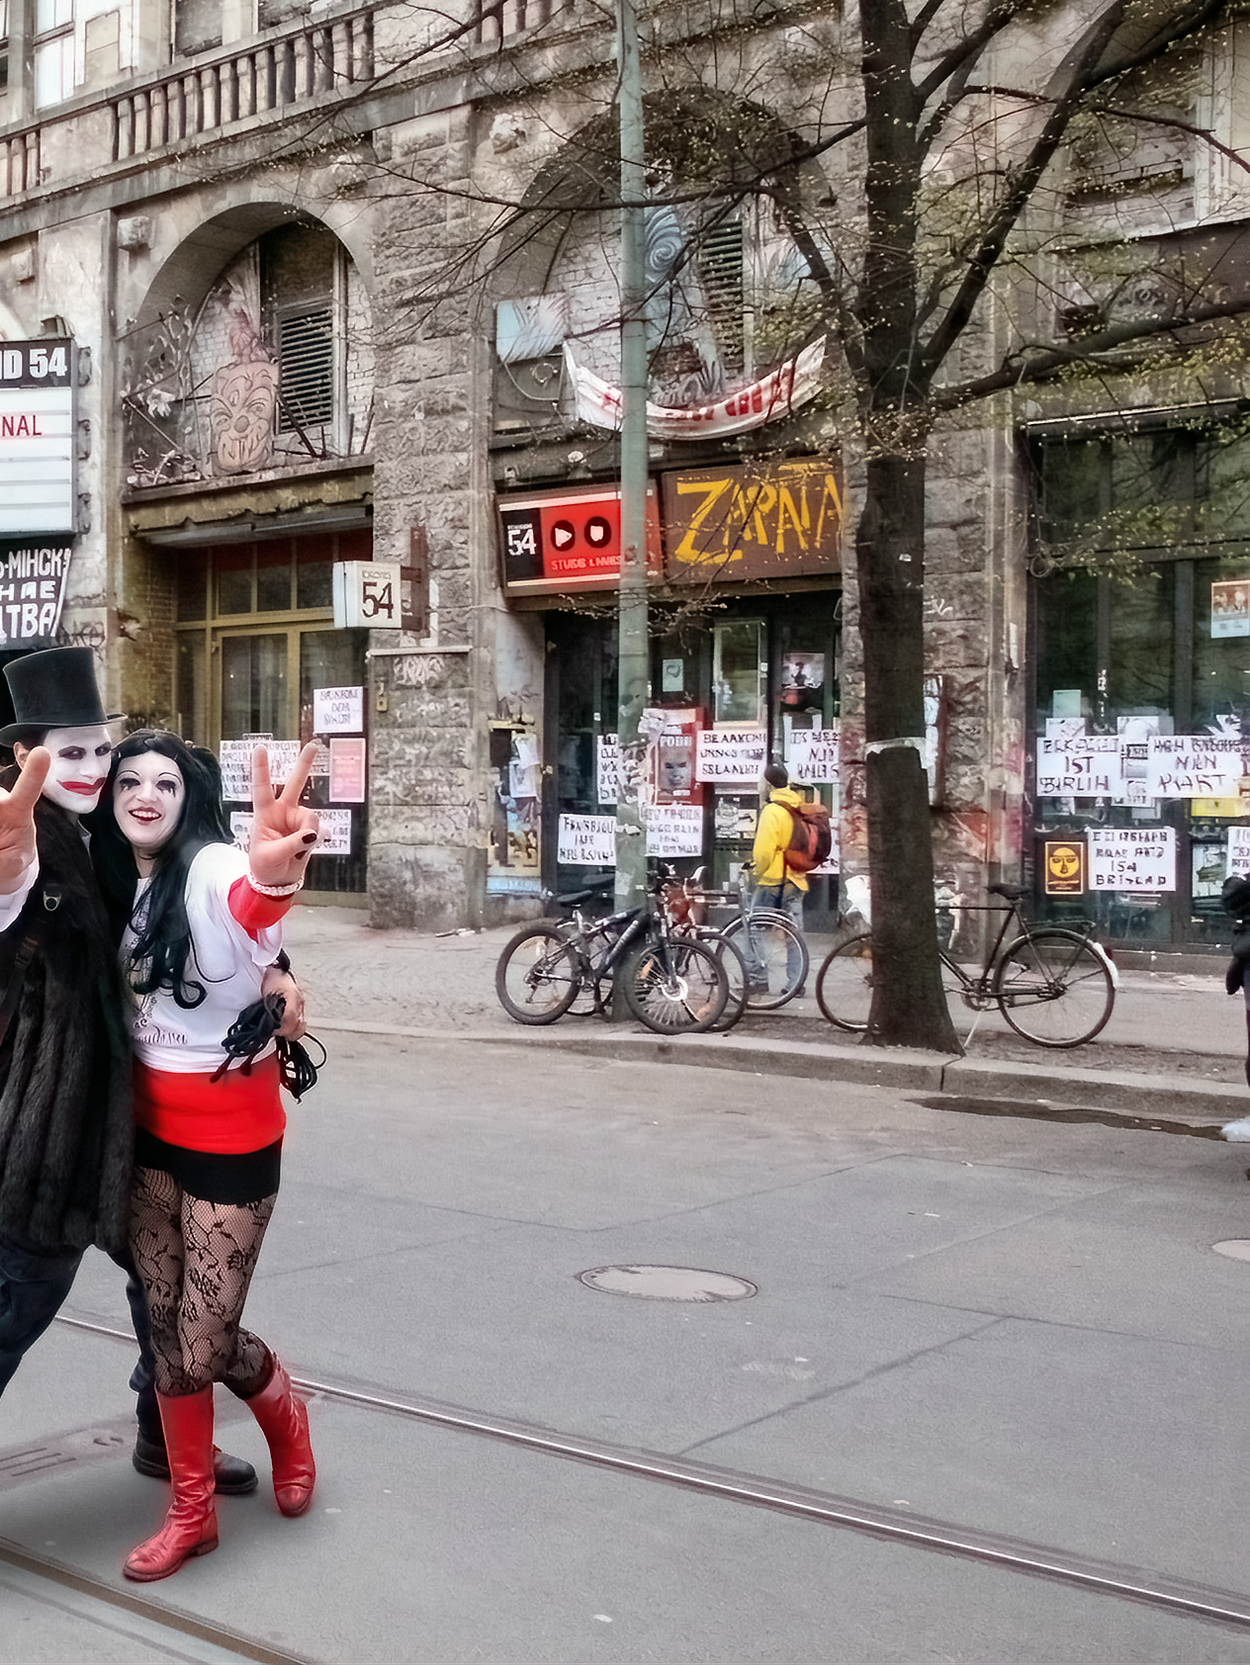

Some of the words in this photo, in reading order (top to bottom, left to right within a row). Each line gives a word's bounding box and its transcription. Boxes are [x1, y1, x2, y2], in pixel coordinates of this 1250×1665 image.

[29, 347, 68, 378] 54
[507, 528, 537, 556] 54
[362, 581, 394, 619] 54
